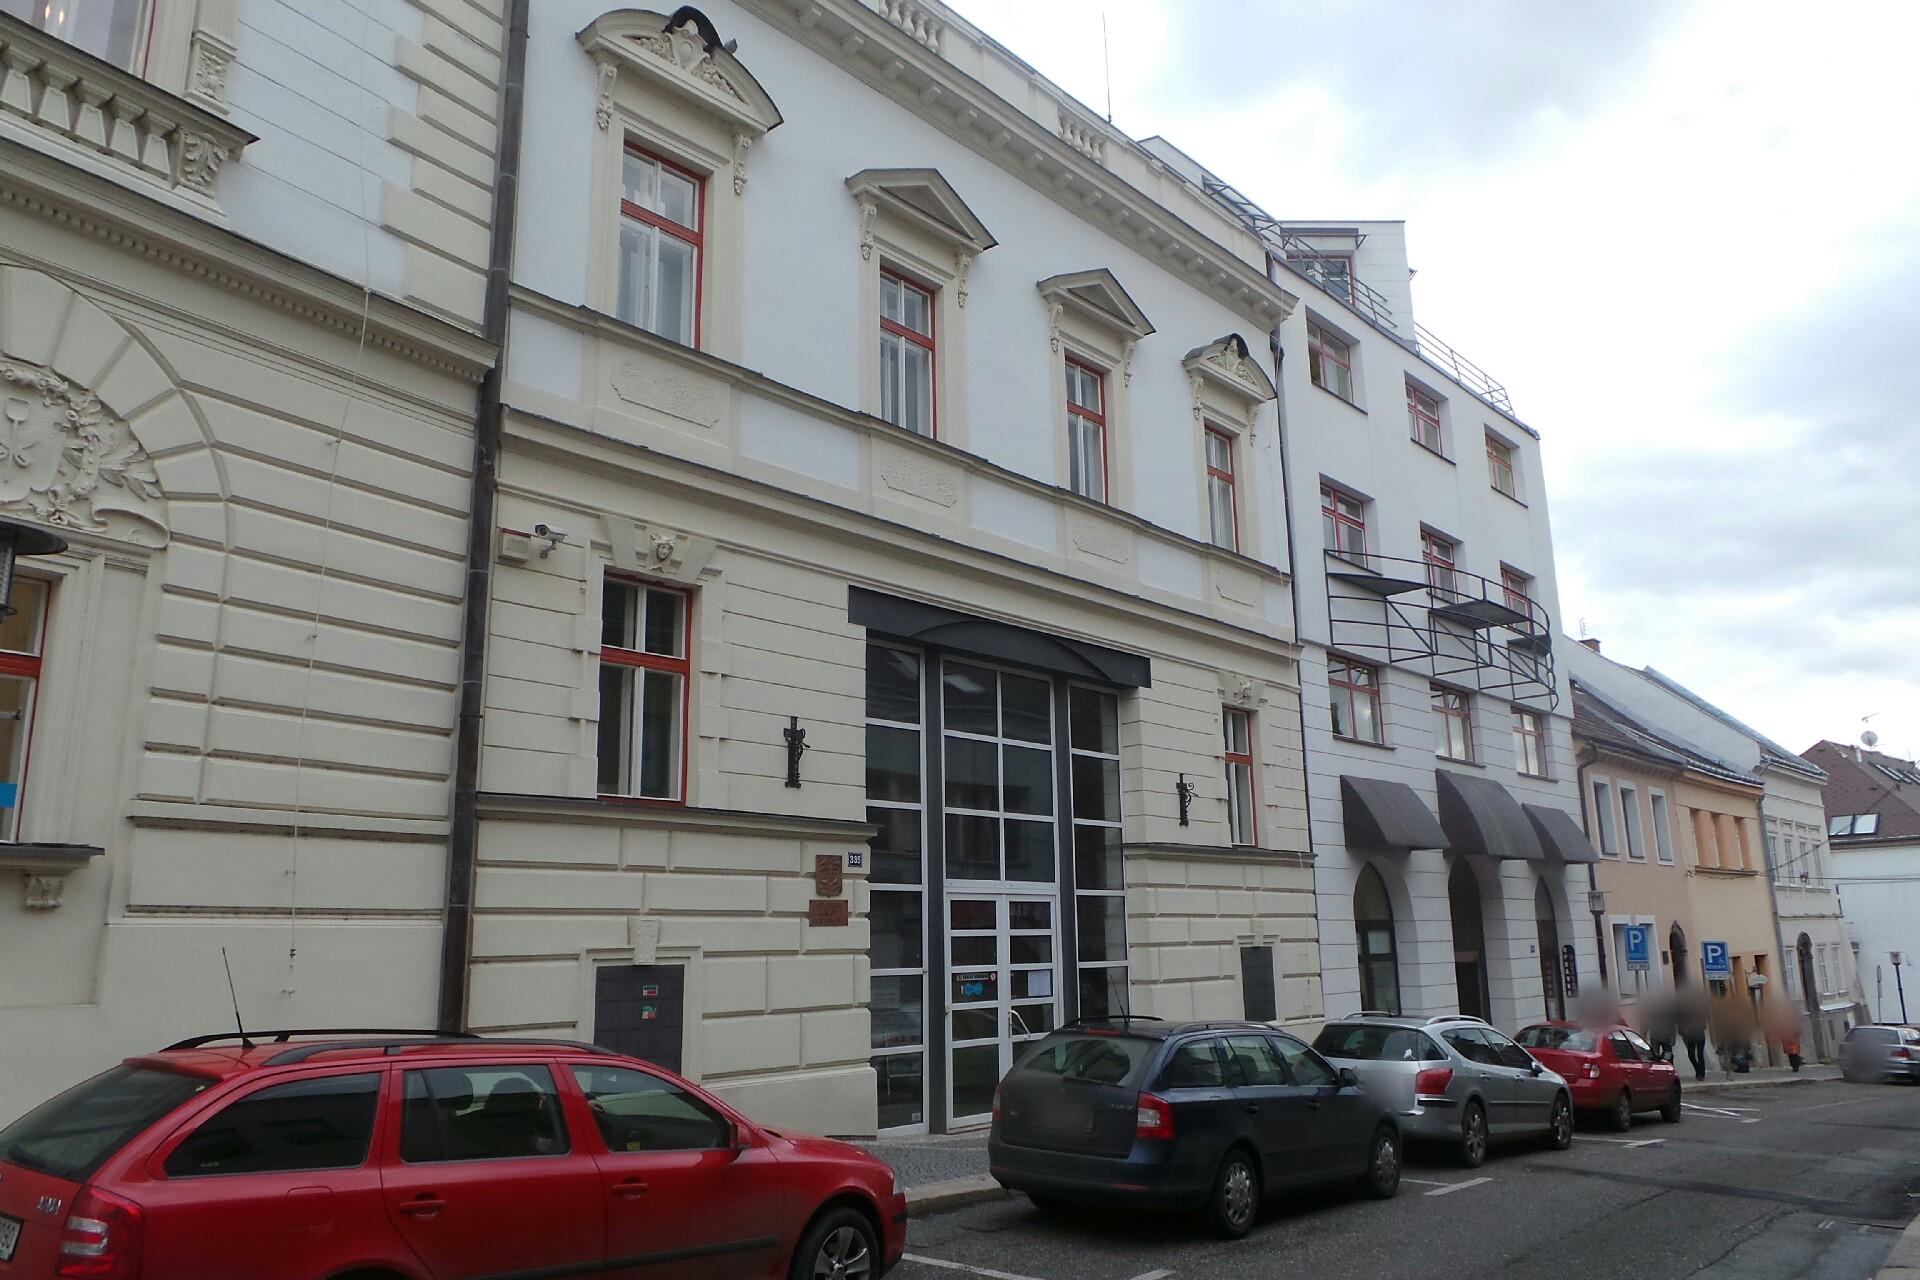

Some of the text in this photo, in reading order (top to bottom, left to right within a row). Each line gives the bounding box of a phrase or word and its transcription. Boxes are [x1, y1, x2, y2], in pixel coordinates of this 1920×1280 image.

[850, 855, 861, 864] 335
[1629, 930, 1642, 951] P
[1707, 945, 1722, 963] P
